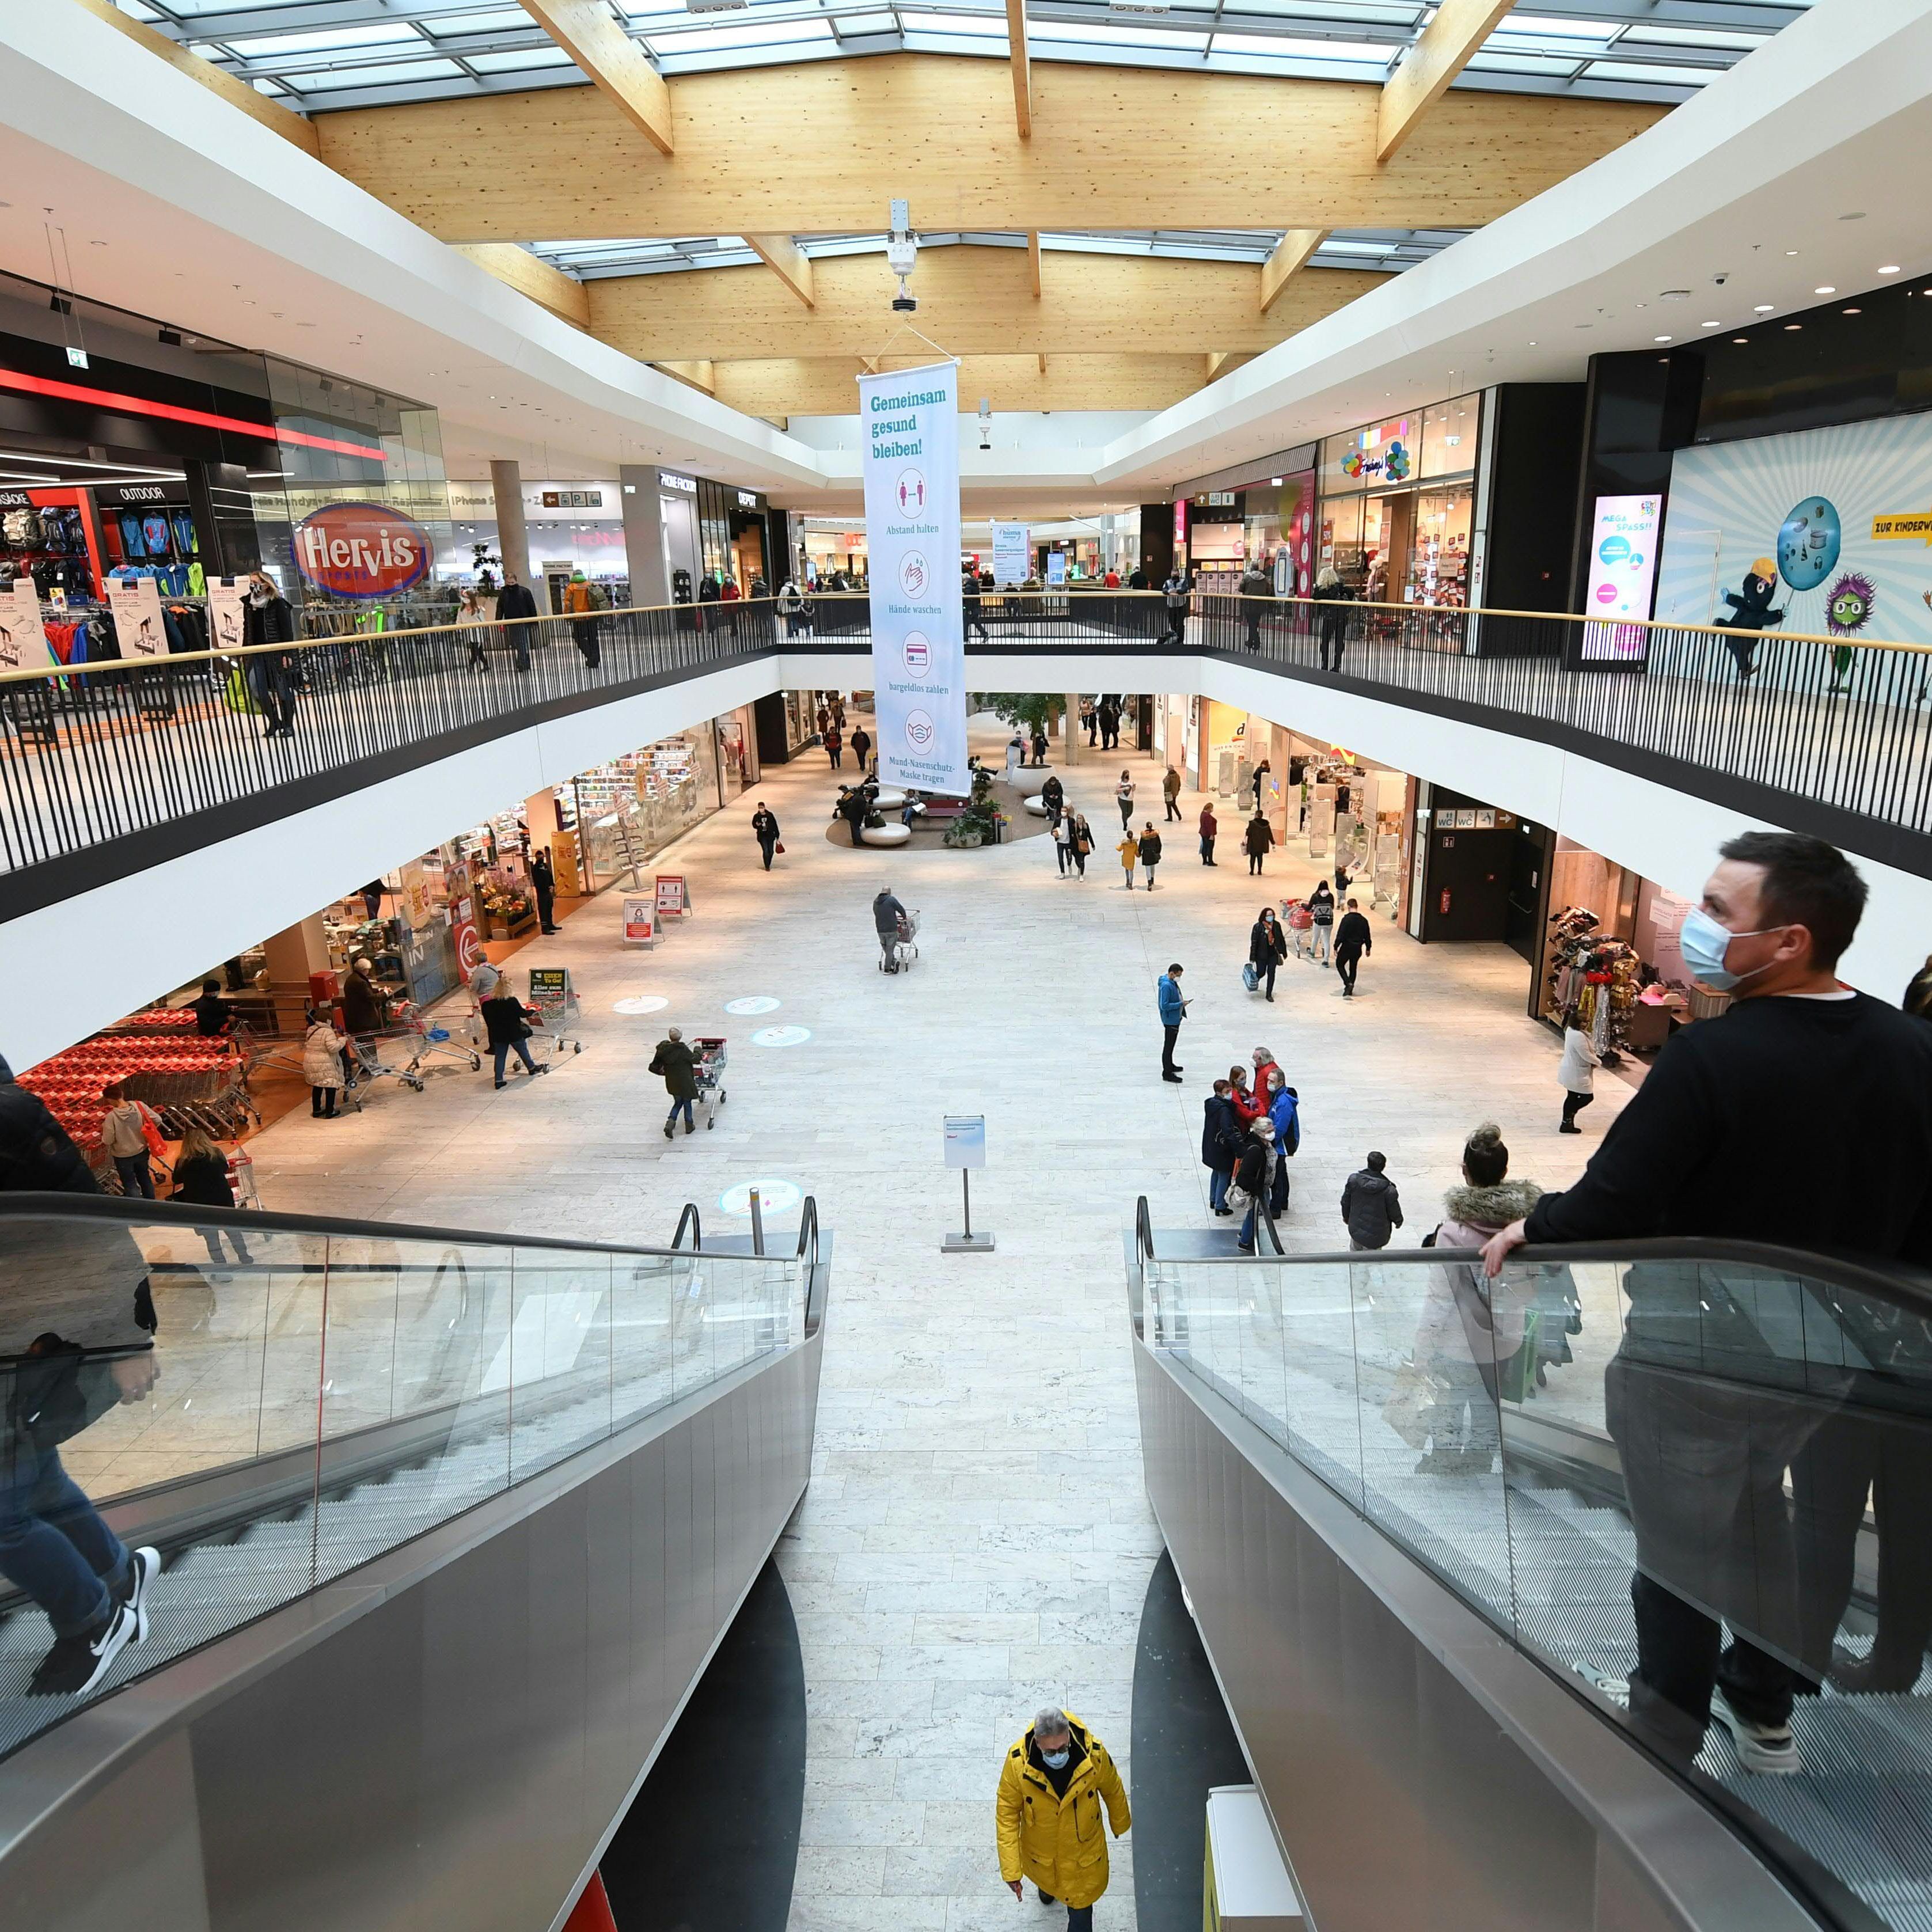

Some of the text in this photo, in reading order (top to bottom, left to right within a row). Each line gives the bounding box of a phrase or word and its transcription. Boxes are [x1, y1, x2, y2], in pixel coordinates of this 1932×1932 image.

[871, 389, 946, 412] Gemeinsam
[871, 415, 917, 439] gesund
[872, 438, 923, 460] bleiben!
[0, 492, 30, 505] SÄCKE
[119, 487, 166, 500] OUTDOOR
[738, 491, 757, 506] DEPOT
[1601, 515, 1627, 523] MEGA
[886, 523, 939, 535] Abstand halten
[1616, 522, 1652, 530] SPASS!!
[1875, 520, 1932, 533] ZUR KINDERW
[302, 527, 415, 577] Hervis
[318, 570, 369, 581] SPORTS
[889, 605, 942, 614] Hände waschen
[889, 682, 949, 694] bargeldlos zahlen
[889, 756, 955, 773] Mund-Nasenschutz-
[899, 769, 945, 784] Maske tragen
[1438, 818, 1453, 826] WC
